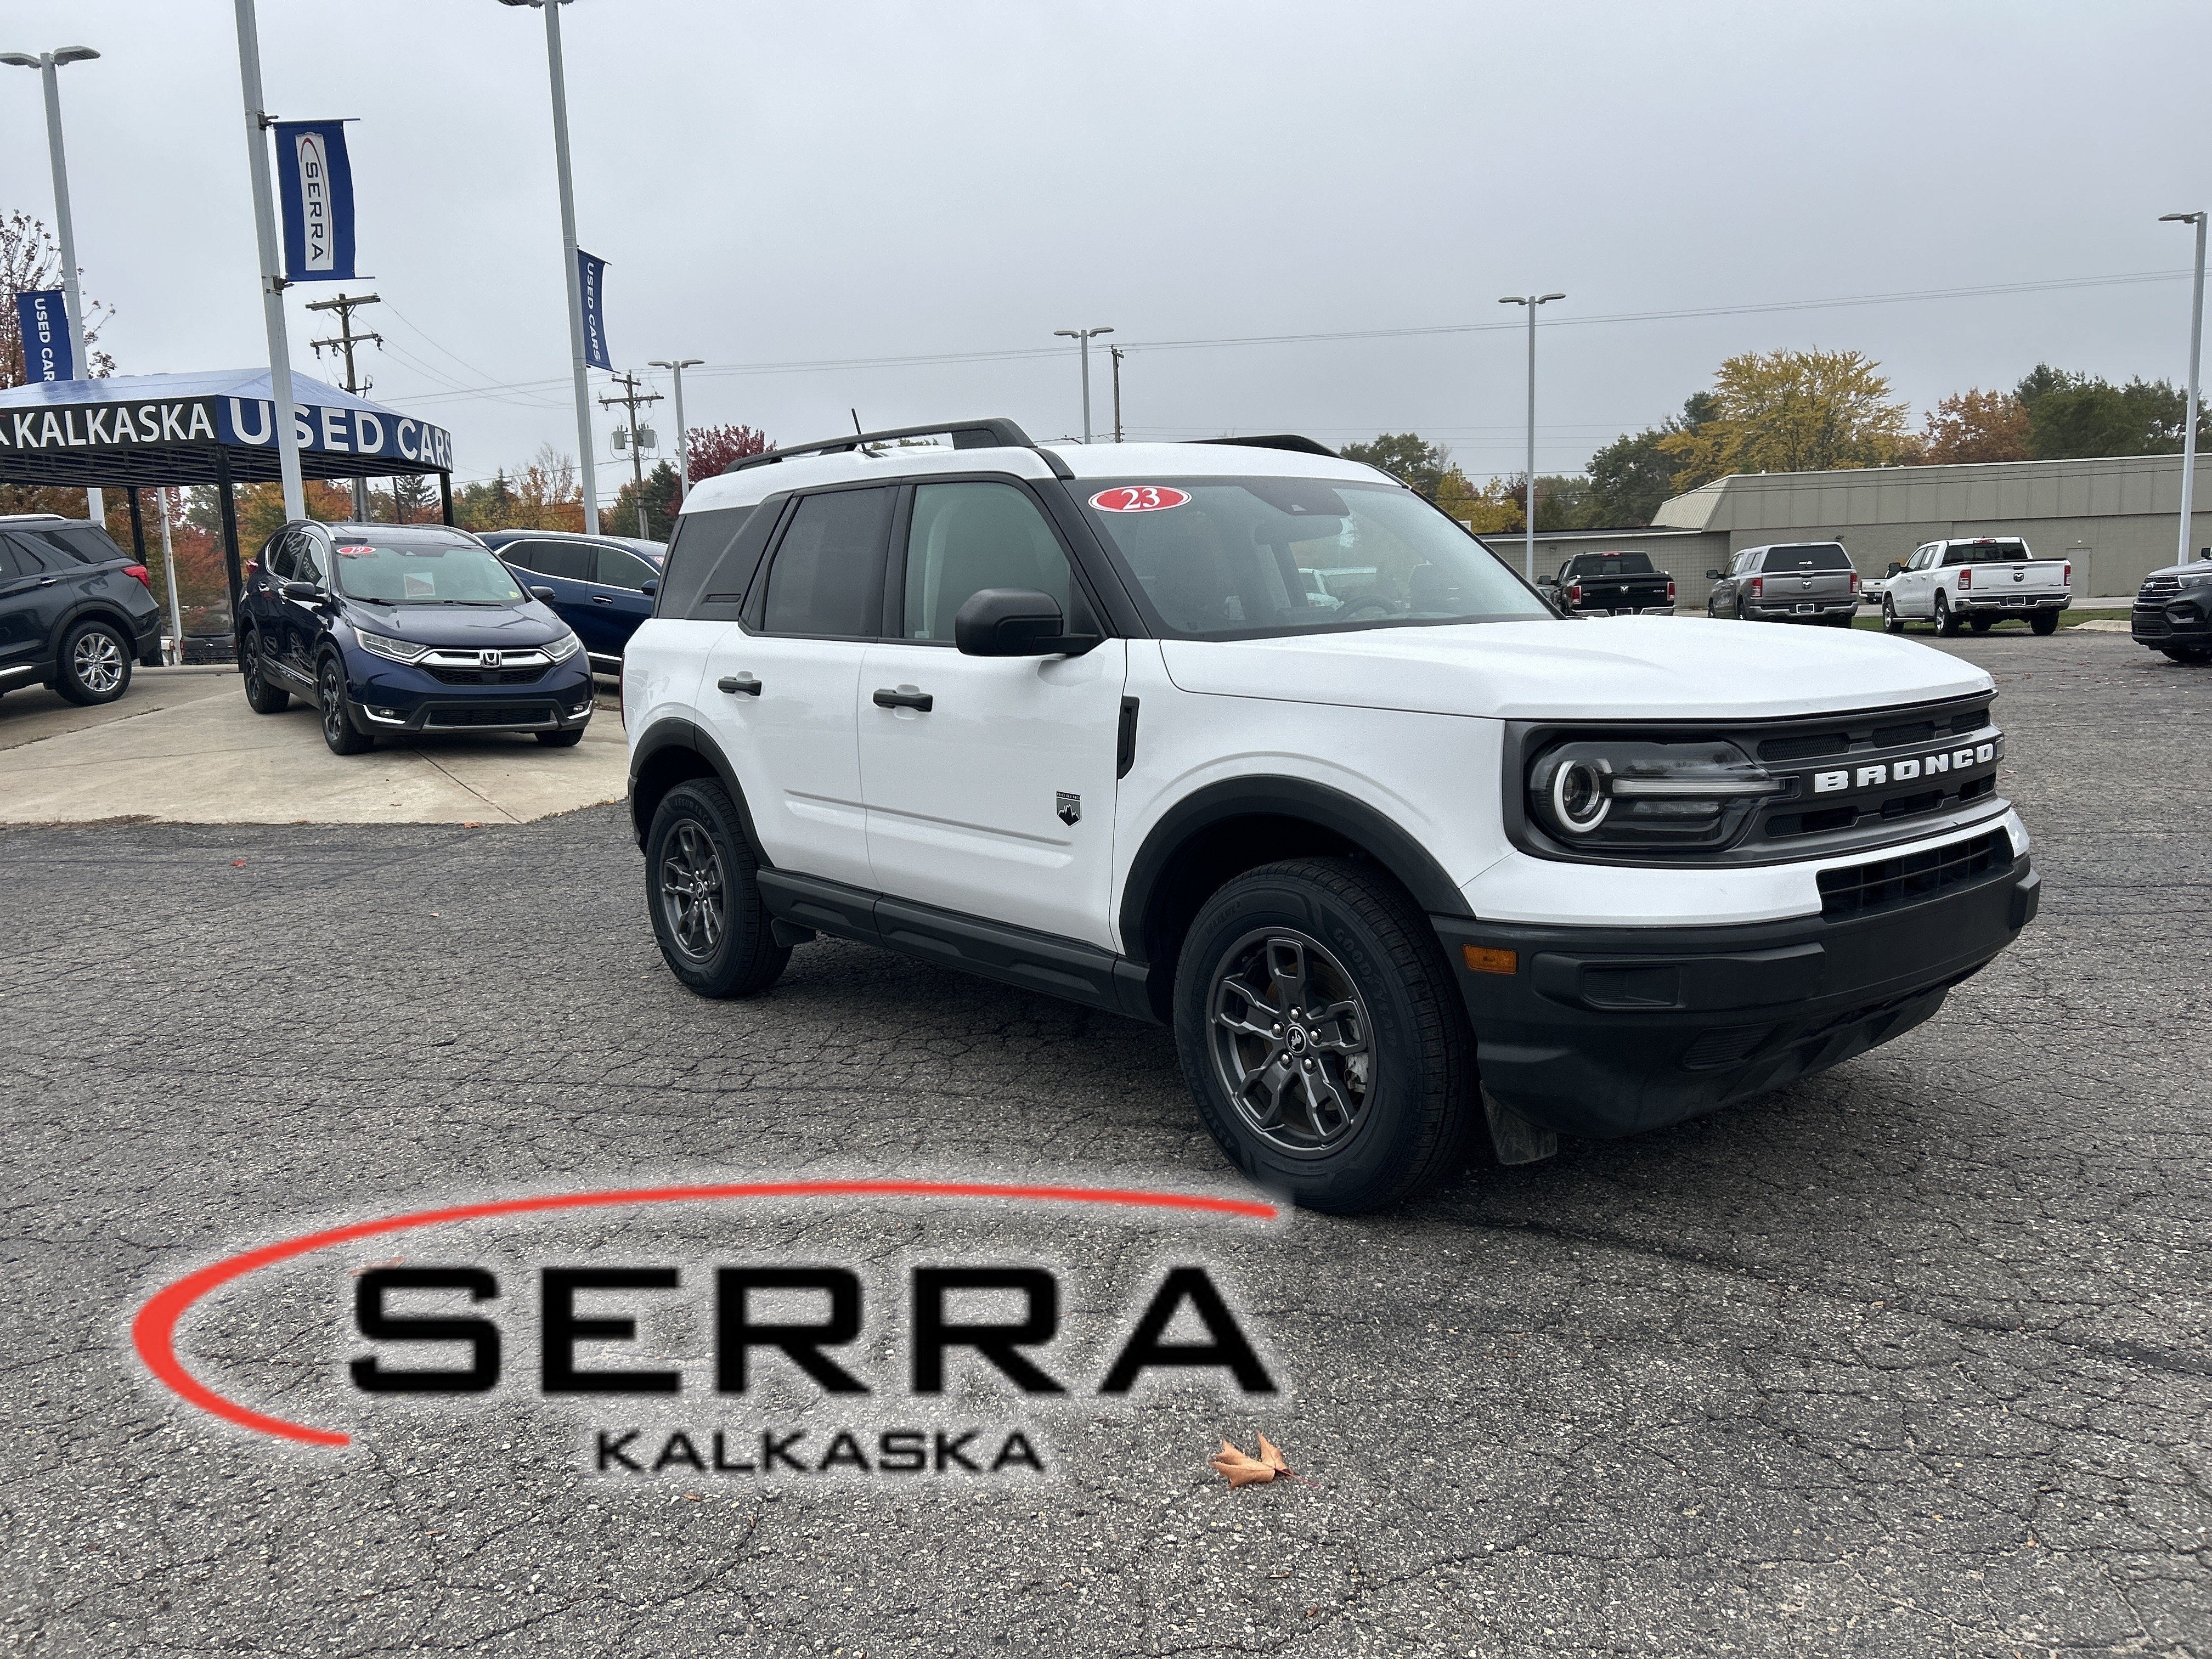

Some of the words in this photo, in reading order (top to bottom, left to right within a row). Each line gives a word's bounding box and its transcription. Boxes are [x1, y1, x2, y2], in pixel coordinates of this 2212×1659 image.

[305, 161, 324, 261] SERRA
[34, 298, 50, 343] USED
[589, 313, 601, 360] CARS
[13, 403, 215, 448] KALKASKA
[229, 397, 385, 454] USED
[397, 418, 452, 470] CARS
[1121, 488, 1160, 510] 23
[1814, 743, 1994, 793] BRONCO
[1334, 927, 1397, 1048] GOODYEAR
